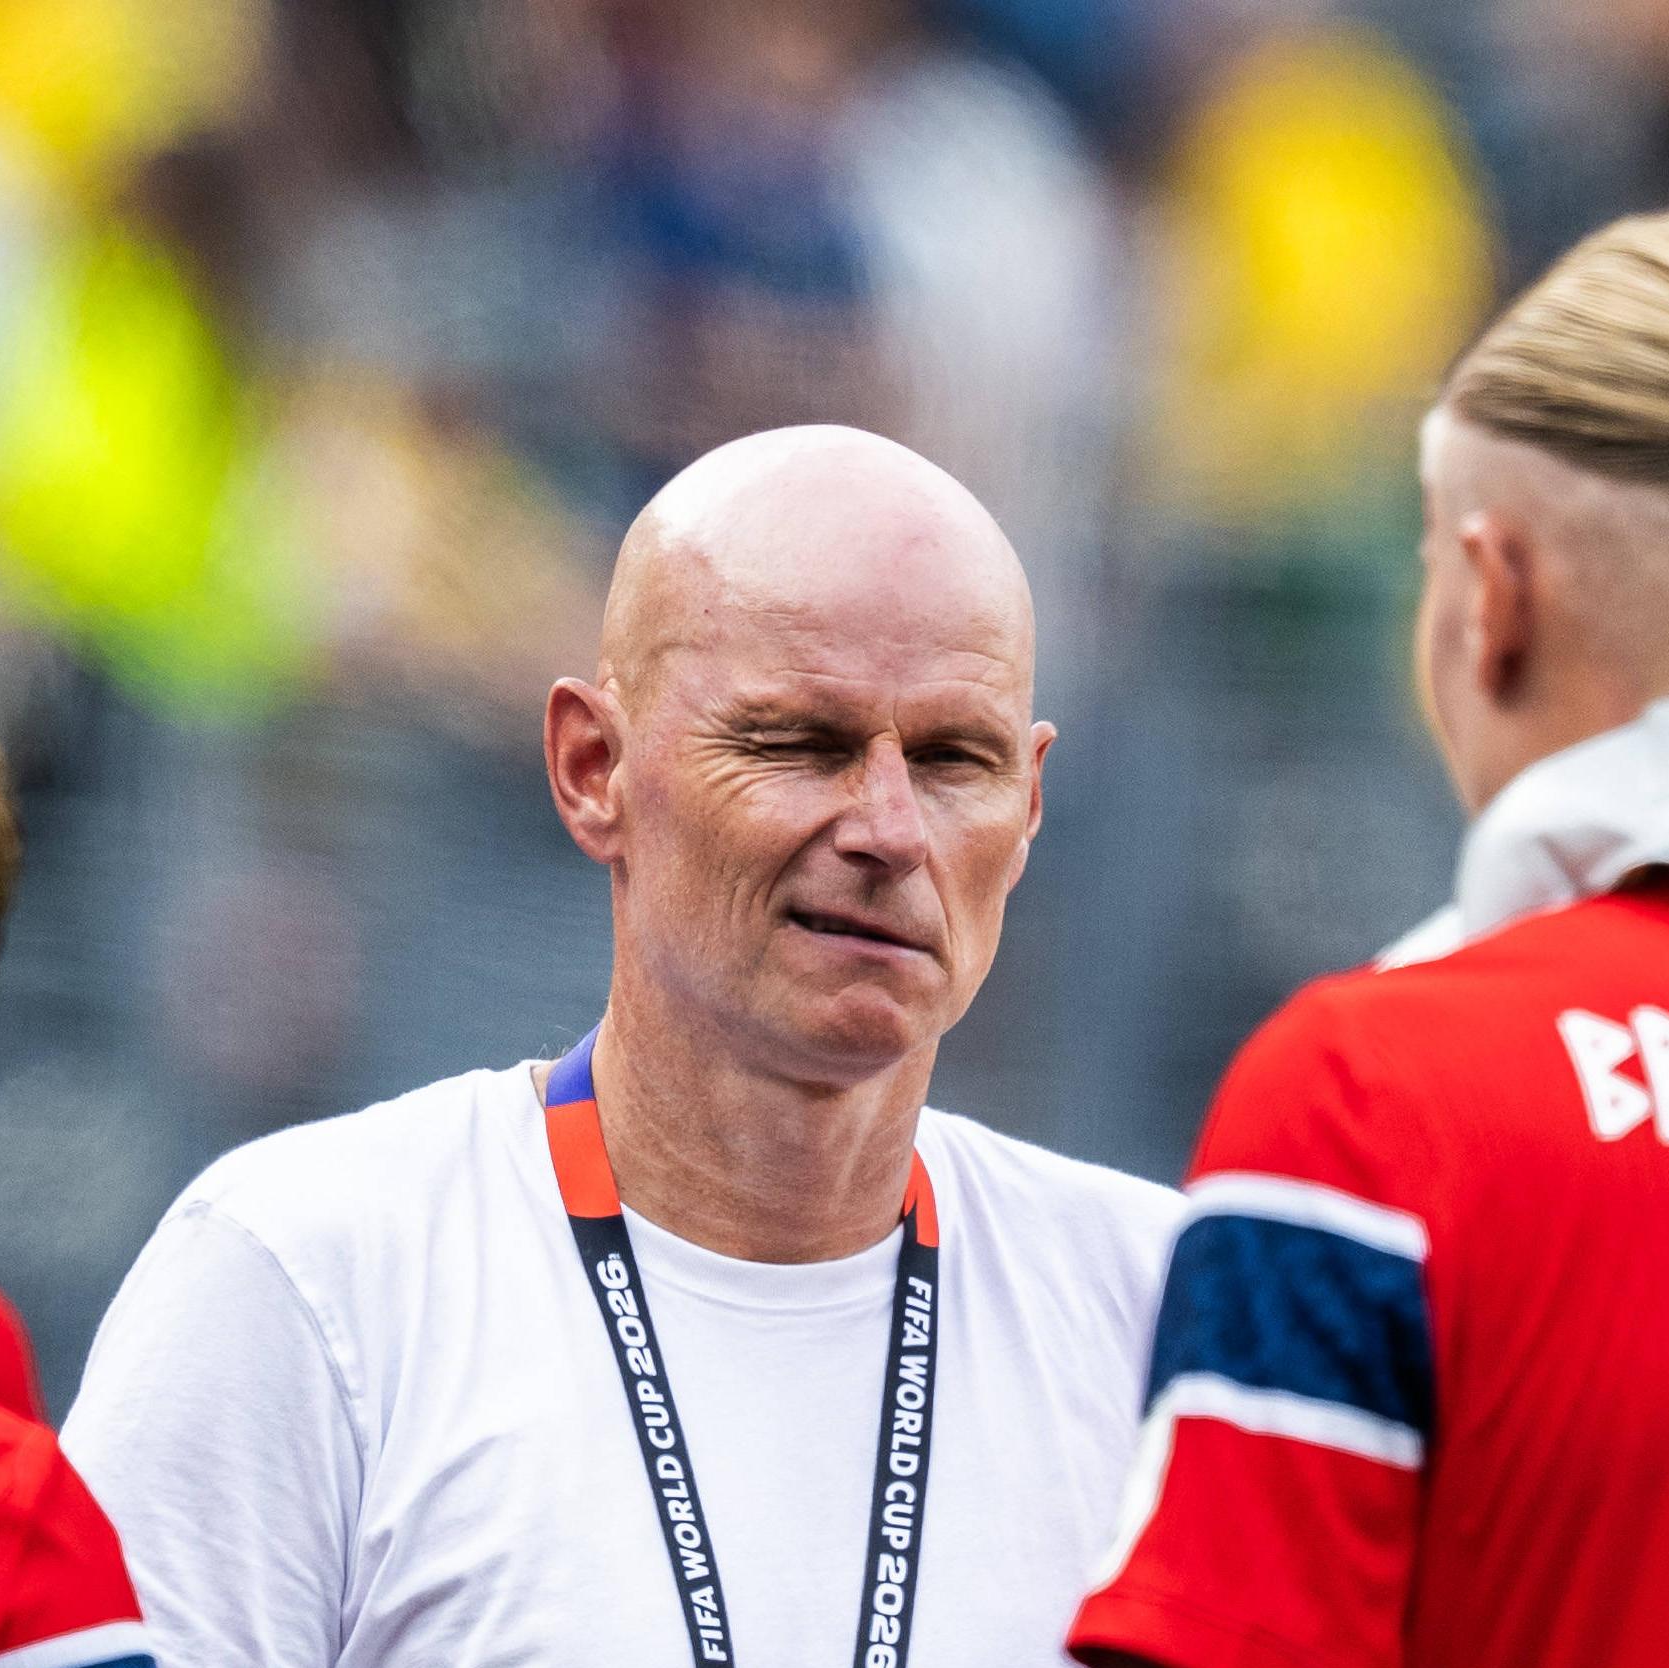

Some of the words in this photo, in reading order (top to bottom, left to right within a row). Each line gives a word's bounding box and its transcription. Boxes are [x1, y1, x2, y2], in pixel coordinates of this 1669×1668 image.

[901, 1276, 932, 1347] FIFA
[638, 1382, 677, 1450] CUP
[889, 1354, 929, 1478] WORLD
[655, 1454, 711, 1581] WORLD
[881, 1484, 915, 1551] CUP
[689, 1589, 728, 1662] FIFA
